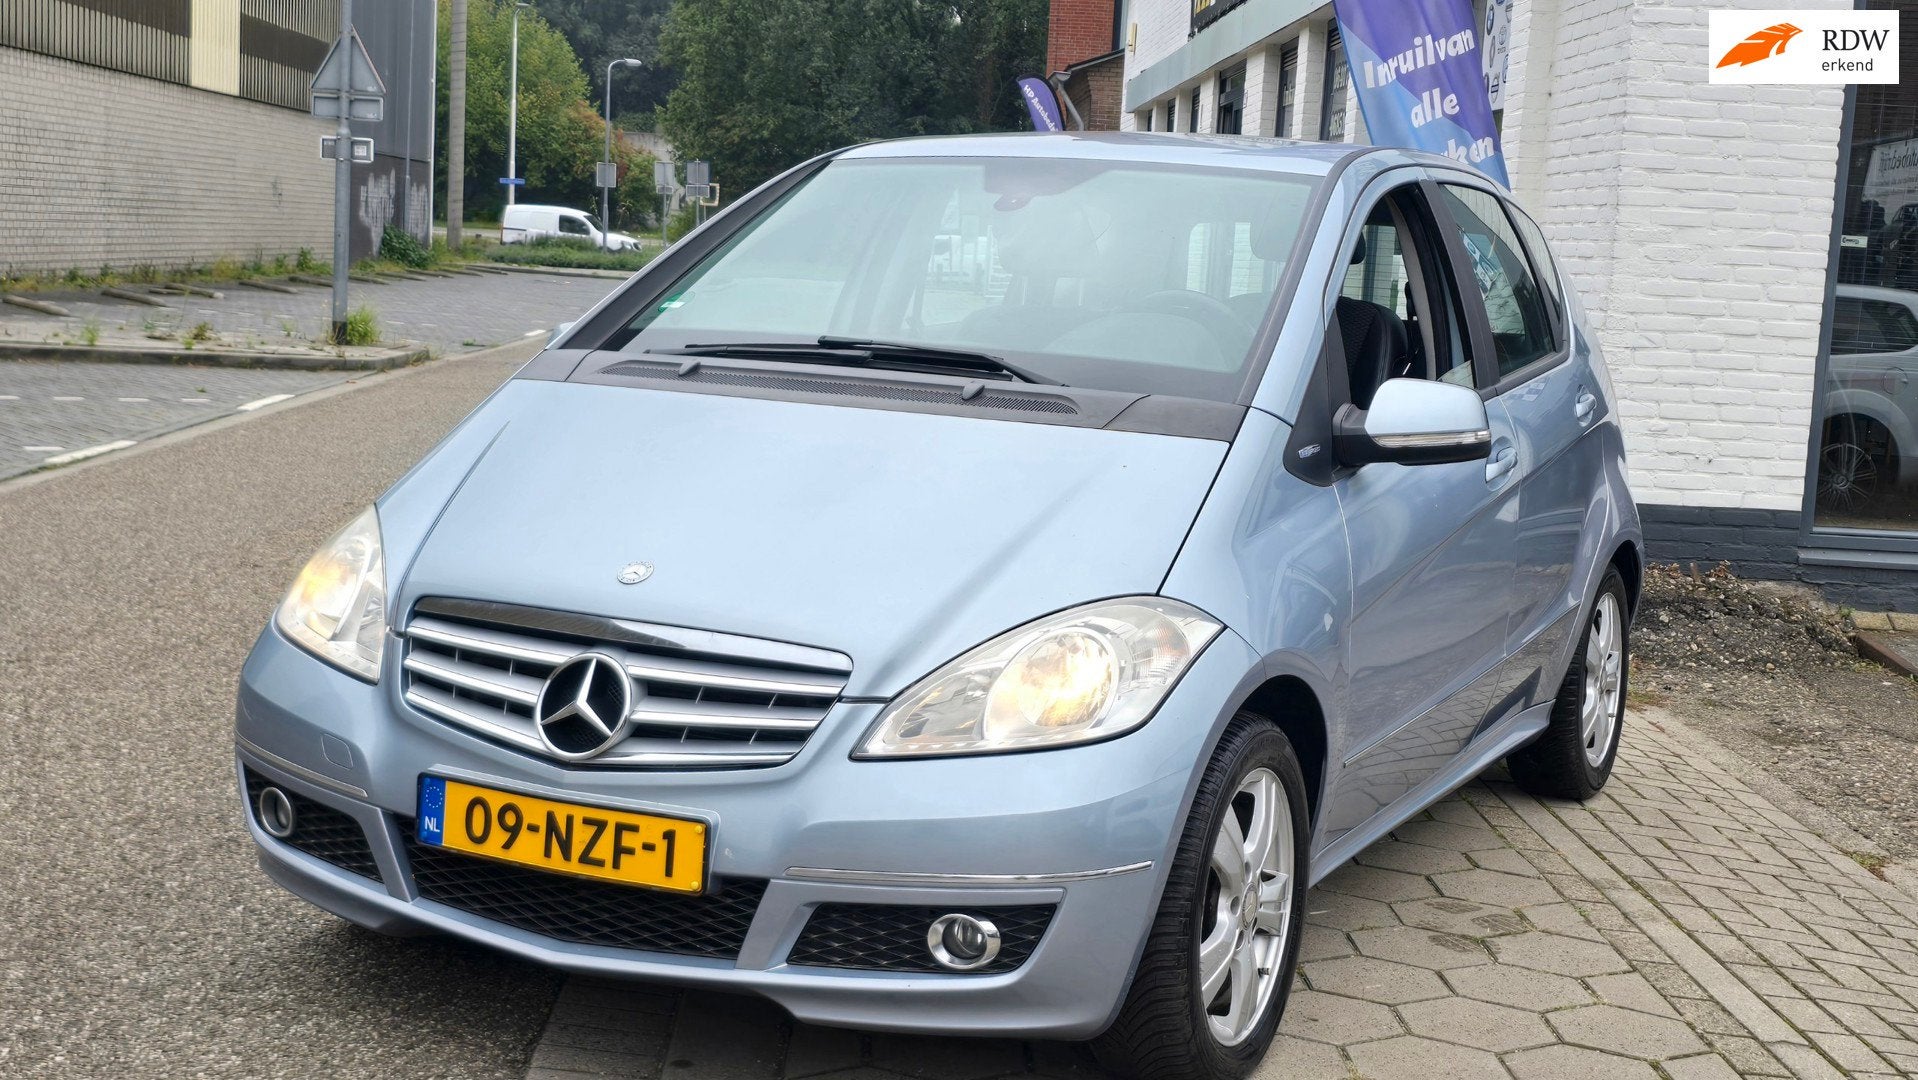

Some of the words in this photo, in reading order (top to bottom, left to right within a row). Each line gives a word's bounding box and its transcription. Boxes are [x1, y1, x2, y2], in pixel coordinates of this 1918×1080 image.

[1411, 87, 1460, 129] alle
[424, 815, 441, 832] NL
[465, 796, 677, 878] 09-NZF-1
